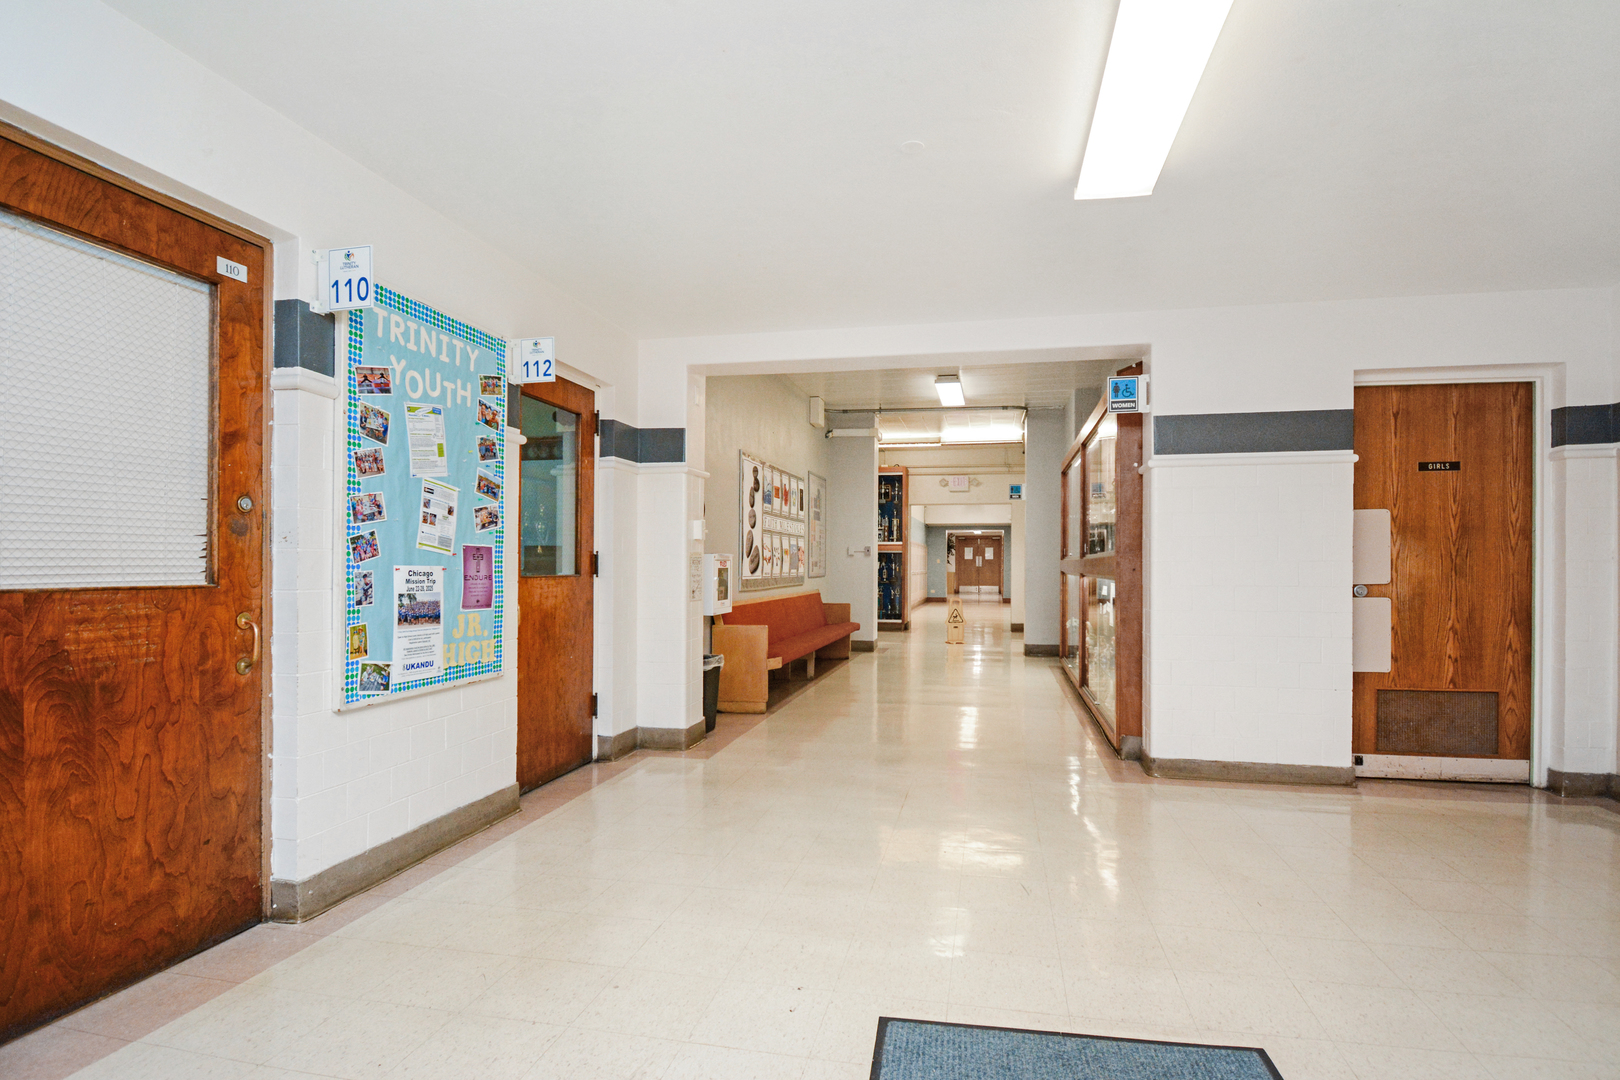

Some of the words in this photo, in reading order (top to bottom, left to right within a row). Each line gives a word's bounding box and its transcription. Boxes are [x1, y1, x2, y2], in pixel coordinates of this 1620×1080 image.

[225, 263, 240, 276] 110
[331, 276, 369, 303] 110
[372, 307, 479, 372] TRINITY
[523, 359, 552, 378] 112
[390, 354, 471, 408] YOUTH
[952, 477, 967, 487] EXIT
[407, 570, 434, 579] Chicago
[427, 578, 437, 586] Trip
[452, 612, 488, 639] JR.
[443, 639, 496, 669] HIGH
[405, 660, 434, 671] UKANDU
